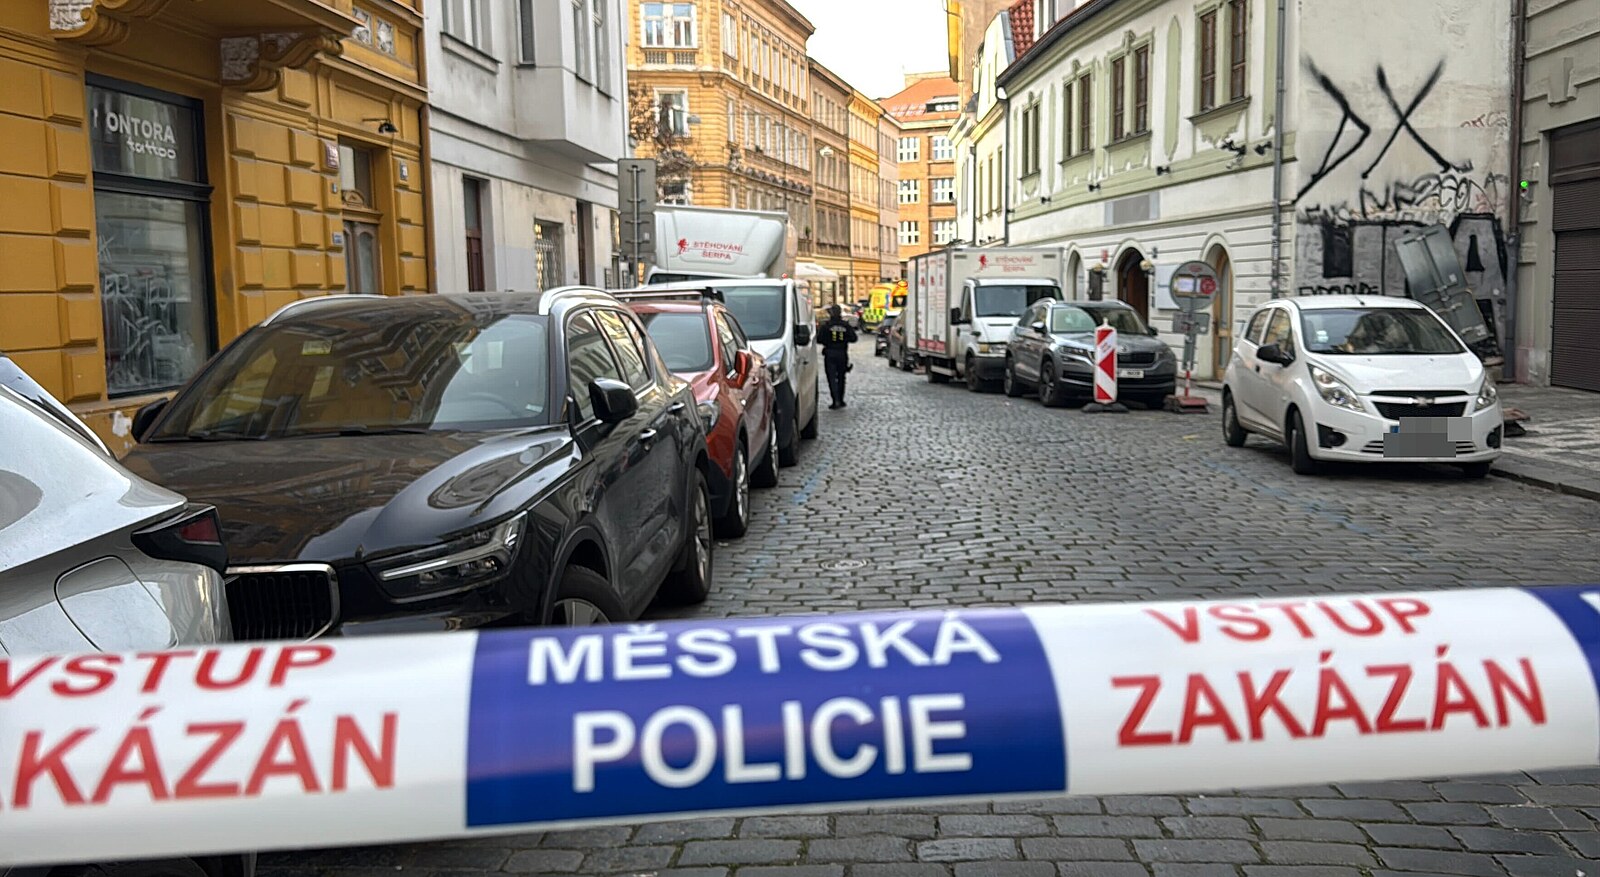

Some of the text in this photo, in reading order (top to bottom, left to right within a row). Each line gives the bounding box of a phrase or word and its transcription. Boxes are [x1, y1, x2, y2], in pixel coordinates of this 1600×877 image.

[126, 137, 177, 159] tattoo
[526, 611, 1001, 686] MĚSTSKÁ
[1143, 598, 1431, 643] VSTUP
[0, 645, 335, 699] VSTUP
[1110, 644, 1548, 748] ZAKÁZÁN
[0, 699, 398, 812] KÁZÁN
[573, 693, 973, 793] POLICIE
